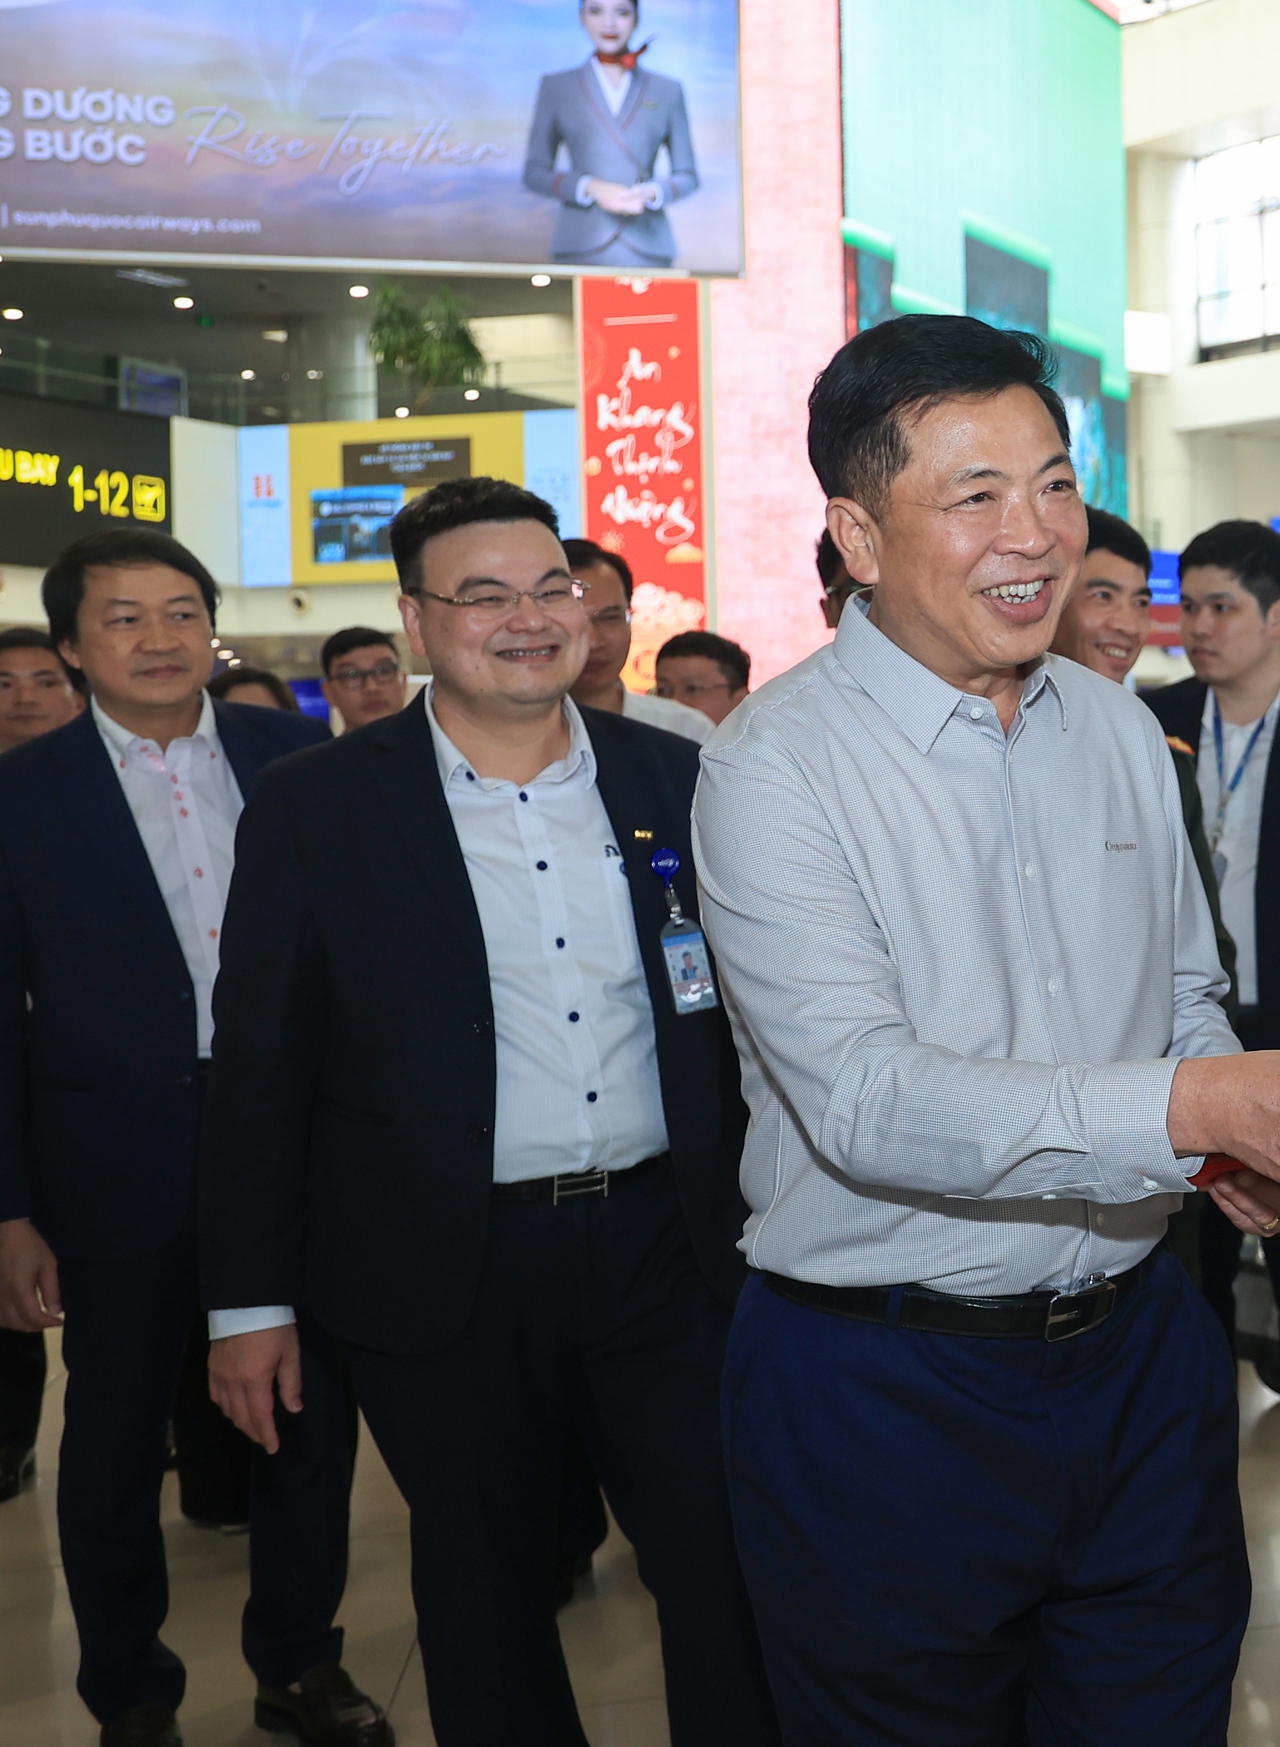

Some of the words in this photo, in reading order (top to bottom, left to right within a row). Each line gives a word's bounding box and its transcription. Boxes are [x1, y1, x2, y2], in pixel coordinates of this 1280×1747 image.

[22, 87, 176, 126] DƯƠNG
[24, 126, 147, 166] BƯỚC
[183, 103, 317, 167] Rise
[316, 109, 508, 196] Together
[12, 209, 262, 236] sunphuquocairways.com
[616, 346, 662, 390] An
[605, 433, 683, 484] Thịnh
[15, 450, 60, 487] BAY
[68, 464, 130, 519] 1-12
